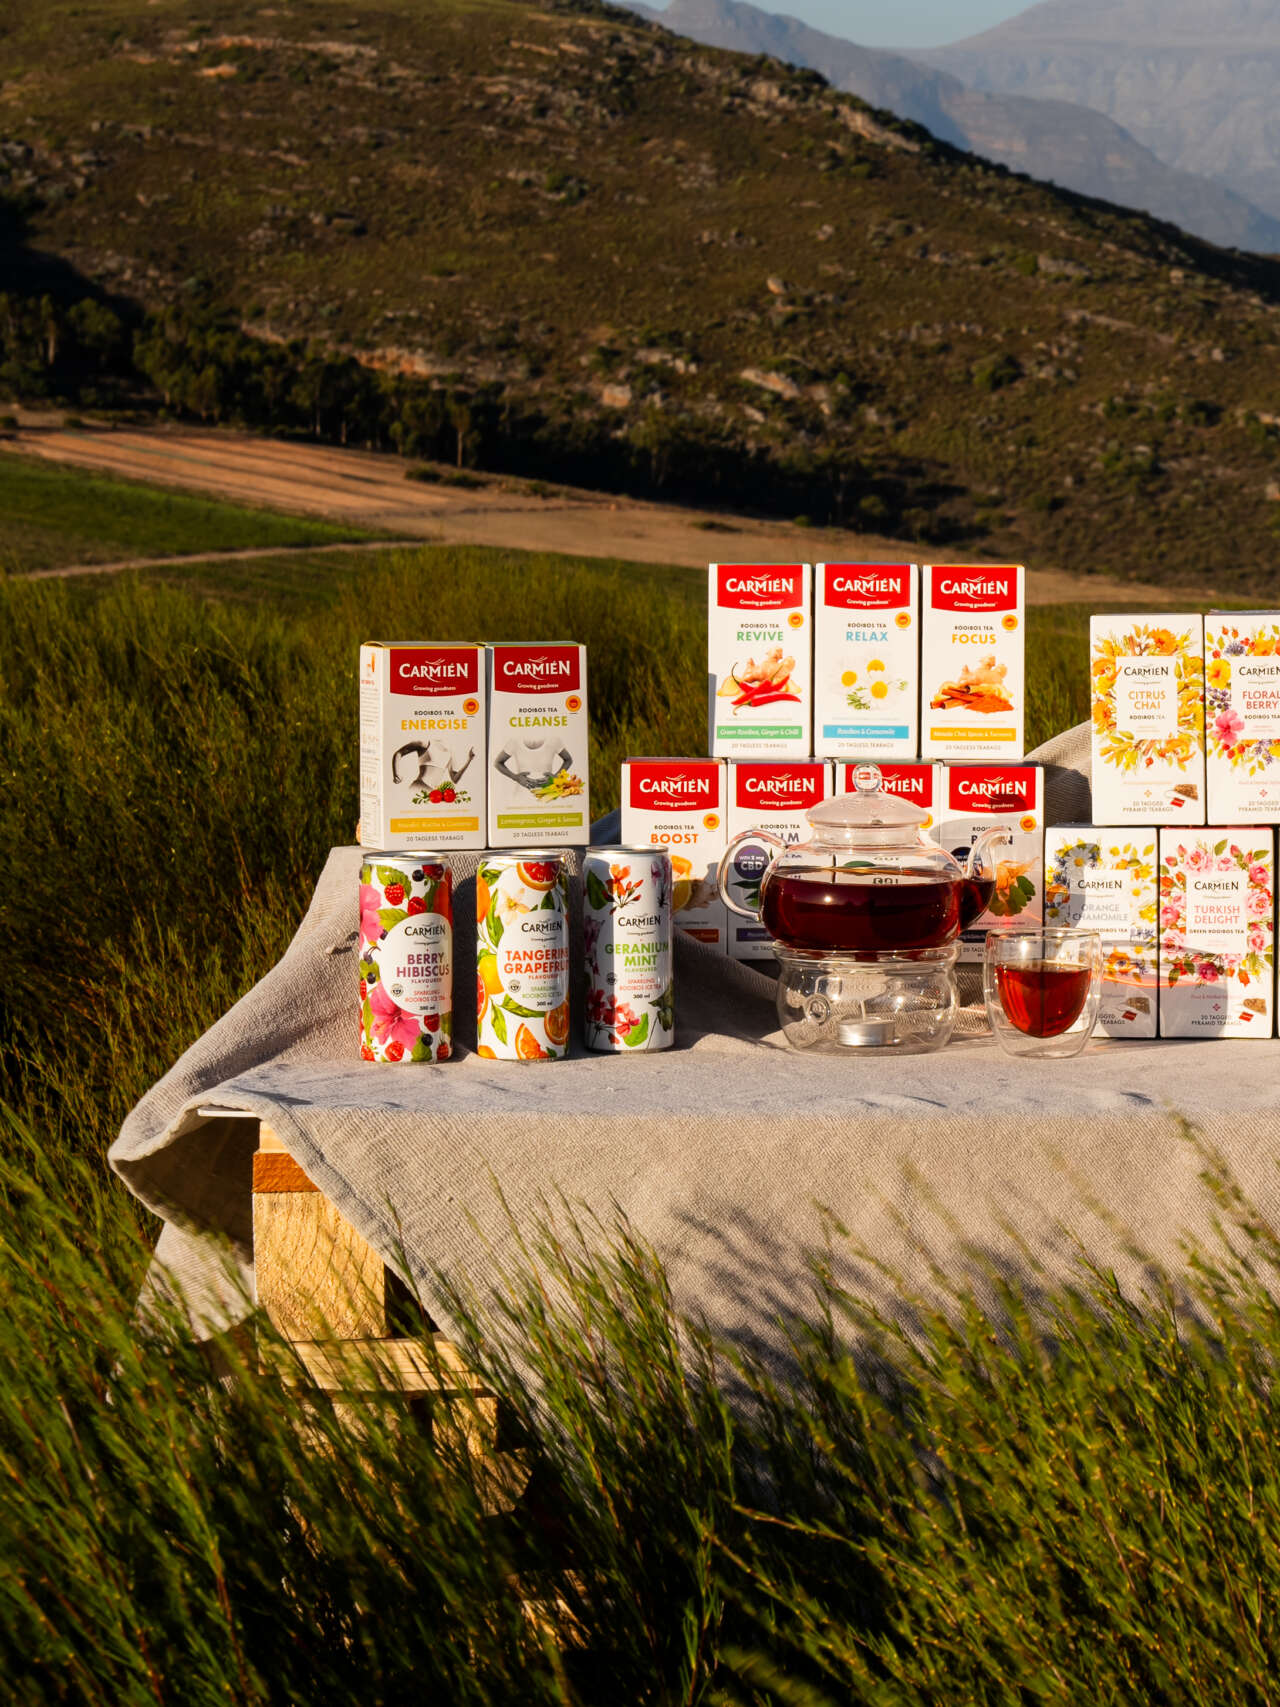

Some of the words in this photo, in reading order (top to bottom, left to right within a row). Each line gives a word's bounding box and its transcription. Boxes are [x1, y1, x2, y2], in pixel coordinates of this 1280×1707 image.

[737, 631, 783, 641] REVIVE
[846, 631, 888, 641] RELAX
[952, 634, 997, 644] FOCUS
[1128, 691, 1166, 700] CITRUS
[1134, 701, 1161, 710] CHAI
[1246, 701, 1279, 709] BERRY
[401, 719, 468, 730] ENERGISE
[509, 716, 568, 727] CLEANSE
[651, 834, 698, 843] BOOST
[741, 861, 763, 871] CBD
[1081, 903, 1119, 912] ORANGE
[1195, 906, 1240, 914] TURKISH
[1073, 913, 1128, 921] CHAMOMILE
[1195, 916, 1239, 924] DELIGHT
[605, 942, 669, 954] GERANIUM
[408, 952, 444, 965] BERRY
[506, 948, 570, 962] TANGERIN
[624, 955, 657, 966] MINT
[396, 964, 449, 978] HIBISCUS
